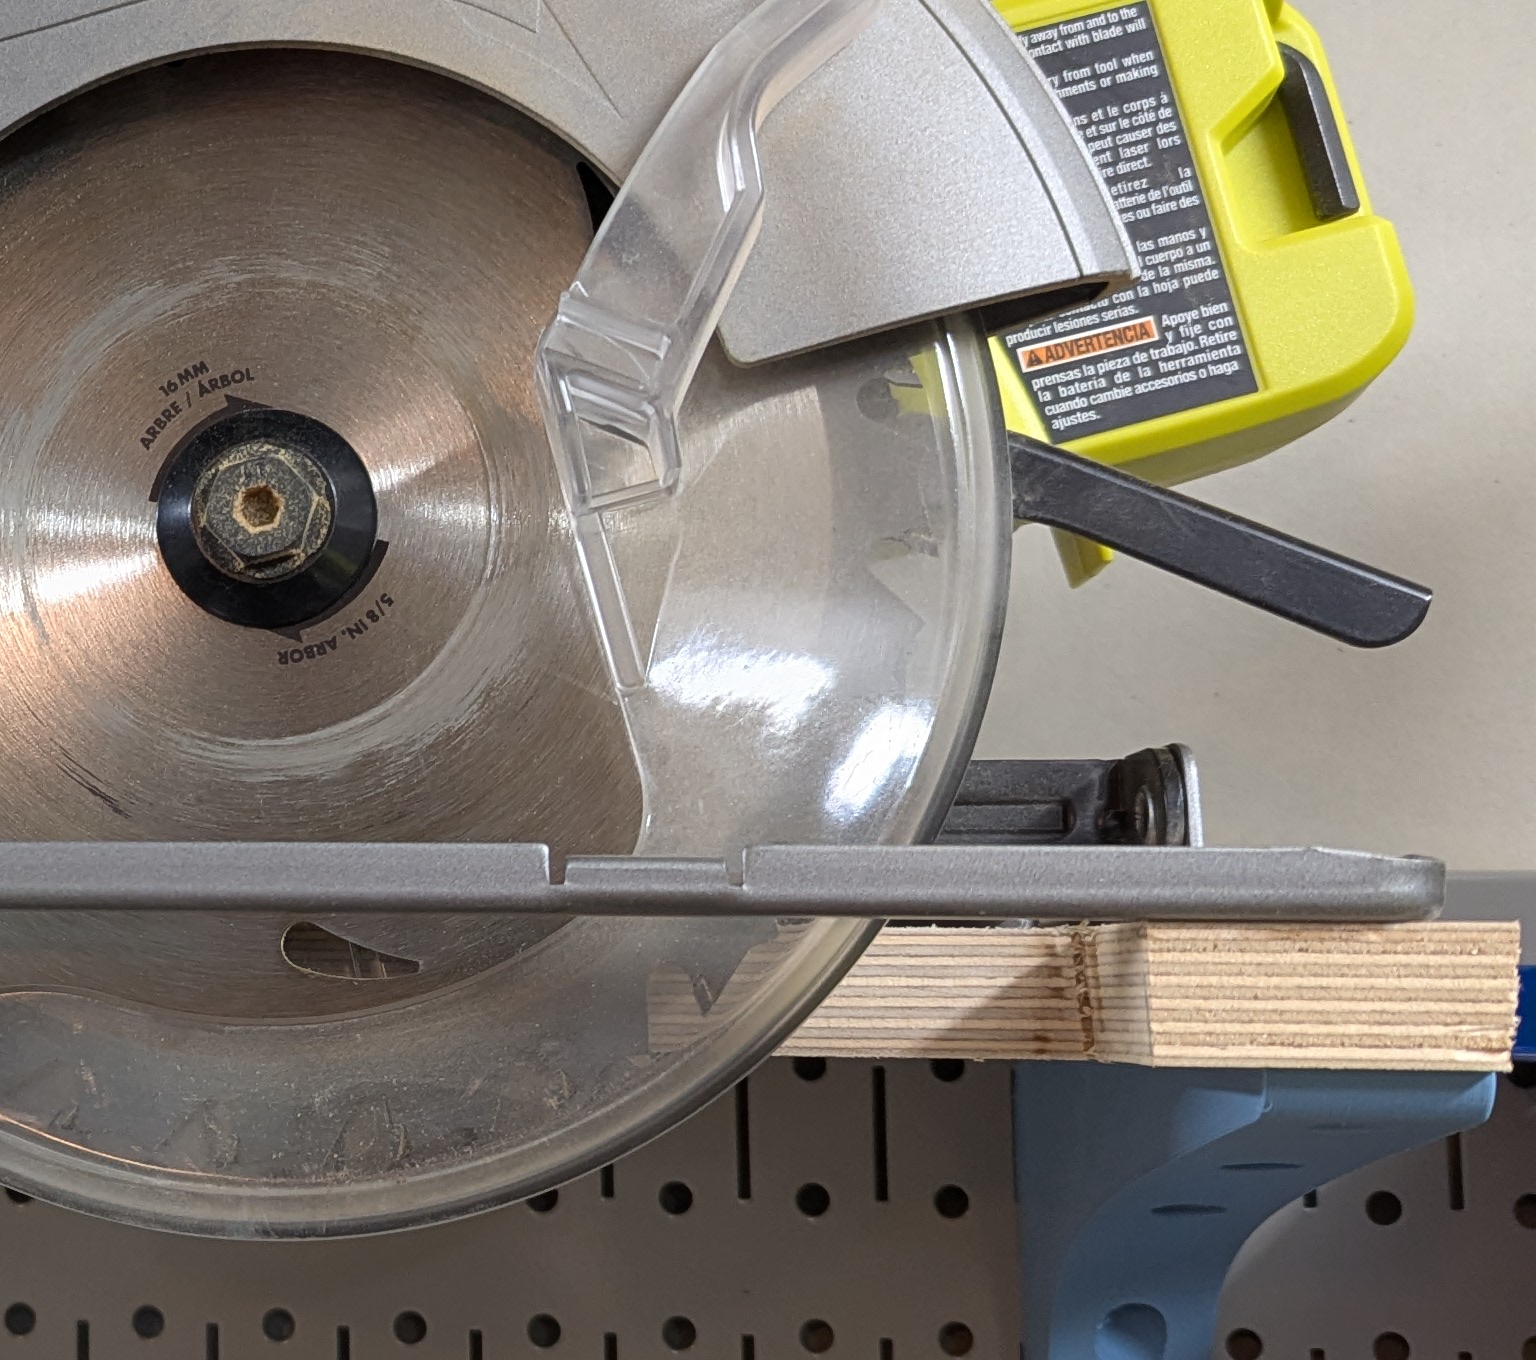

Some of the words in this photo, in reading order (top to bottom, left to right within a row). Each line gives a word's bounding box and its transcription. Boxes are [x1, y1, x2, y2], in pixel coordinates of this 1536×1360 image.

[1030, 28, 1058, 43] away
[1058, 21, 1085, 35] from
[1085, 13, 1106, 29] and
[1106, 12, 1119, 23] to
[1119, 7, 1137, 20] the
[1064, 33, 1090, 48] with
[1091, 25, 1123, 42] blade
[1125, 17, 1146, 33] will
[1062, 67, 1091, 82] from
[1094, 58, 1118, 74] tool
[1121, 51, 1154, 67] when
[1099, 76, 1111, 87] or
[1115, 64, 1159, 83] making
[1085, 125, 1098, 137] et
[1098, 122, 1116, 134] sur
[1118, 117, 1130, 129] le
[1157, 107, 1172, 119] de
[1091, 108, 1104, 121] et
[1106, 105, 1119, 117] le
[1122, 97, 1156, 113] corps
[1115, 127, 1152, 144] causer
[1156, 121, 1177, 134] des
[1118, 143, 1148, 158] laser
[1156, 135, 1181, 149] lors
[1177, 167, 1192, 178] la
[1135, 207, 1151, 219] ou
[1150, 200, 1177, 215] faire
[1178, 195, 1199, 208] des
[1147, 189, 1161, 201] de
[1135, 240, 1155, 252] las
[1157, 230, 1196, 247] manos
[1198, 226, 1206, 239] y
[1145, 248, 1183, 265] cuerpo
[1185, 245, 1194, 255] a
[1195, 241, 1211, 252] un
[1139, 269, 1155, 281] de
[1157, 265, 1170, 277] la
[1173, 256, 1215, 273] misma.
[1112, 290, 1134, 303] con
[1136, 285, 1150, 297] la
[1152, 278, 1179, 293] hoja
[1182, 268, 1219, 289] puede
[1161, 309, 1199, 327] Apoye
[1200, 302, 1228, 317] bien
[1005, 325, 1051, 346] producir
[1053, 314, 1100, 333] lesiones
[1045, 323, 1150, 361] ADVERTENCIA
[1164, 330, 1173, 344] y
[1178, 324, 1202, 338] fije
[1208, 316, 1233, 330] con
[177, 361, 209, 386] MM
[1031, 368, 1081, 391] prensas
[1082, 364, 1095, 376] la
[1096, 356, 1130, 375] pieza
[1132, 351, 1148, 364] de
[1149, 340, 1197, 359] trabajo.
[1198, 330, 1237, 347] Retire
[1037, 390, 1051, 402] la
[1113, 371, 1131, 384] de
[1137, 366, 1151, 378] la
[1158, 344, 1241, 372] herramienta
[1044, 397, 1088, 415] cuando
[1089, 386, 1132, 405] cambie
[1134, 371, 1197, 394] accesorios
[1198, 369, 1207, 378] o
[1207, 360, 1238, 376] haga
[140, 401, 182, 451] ARBRE
[1051, 410, 1100, 430] ajustes.
[366, 593, 394, 623] 5/8
[342, 619, 368, 639] IN.
[277, 636, 336, 664] ARBOR
